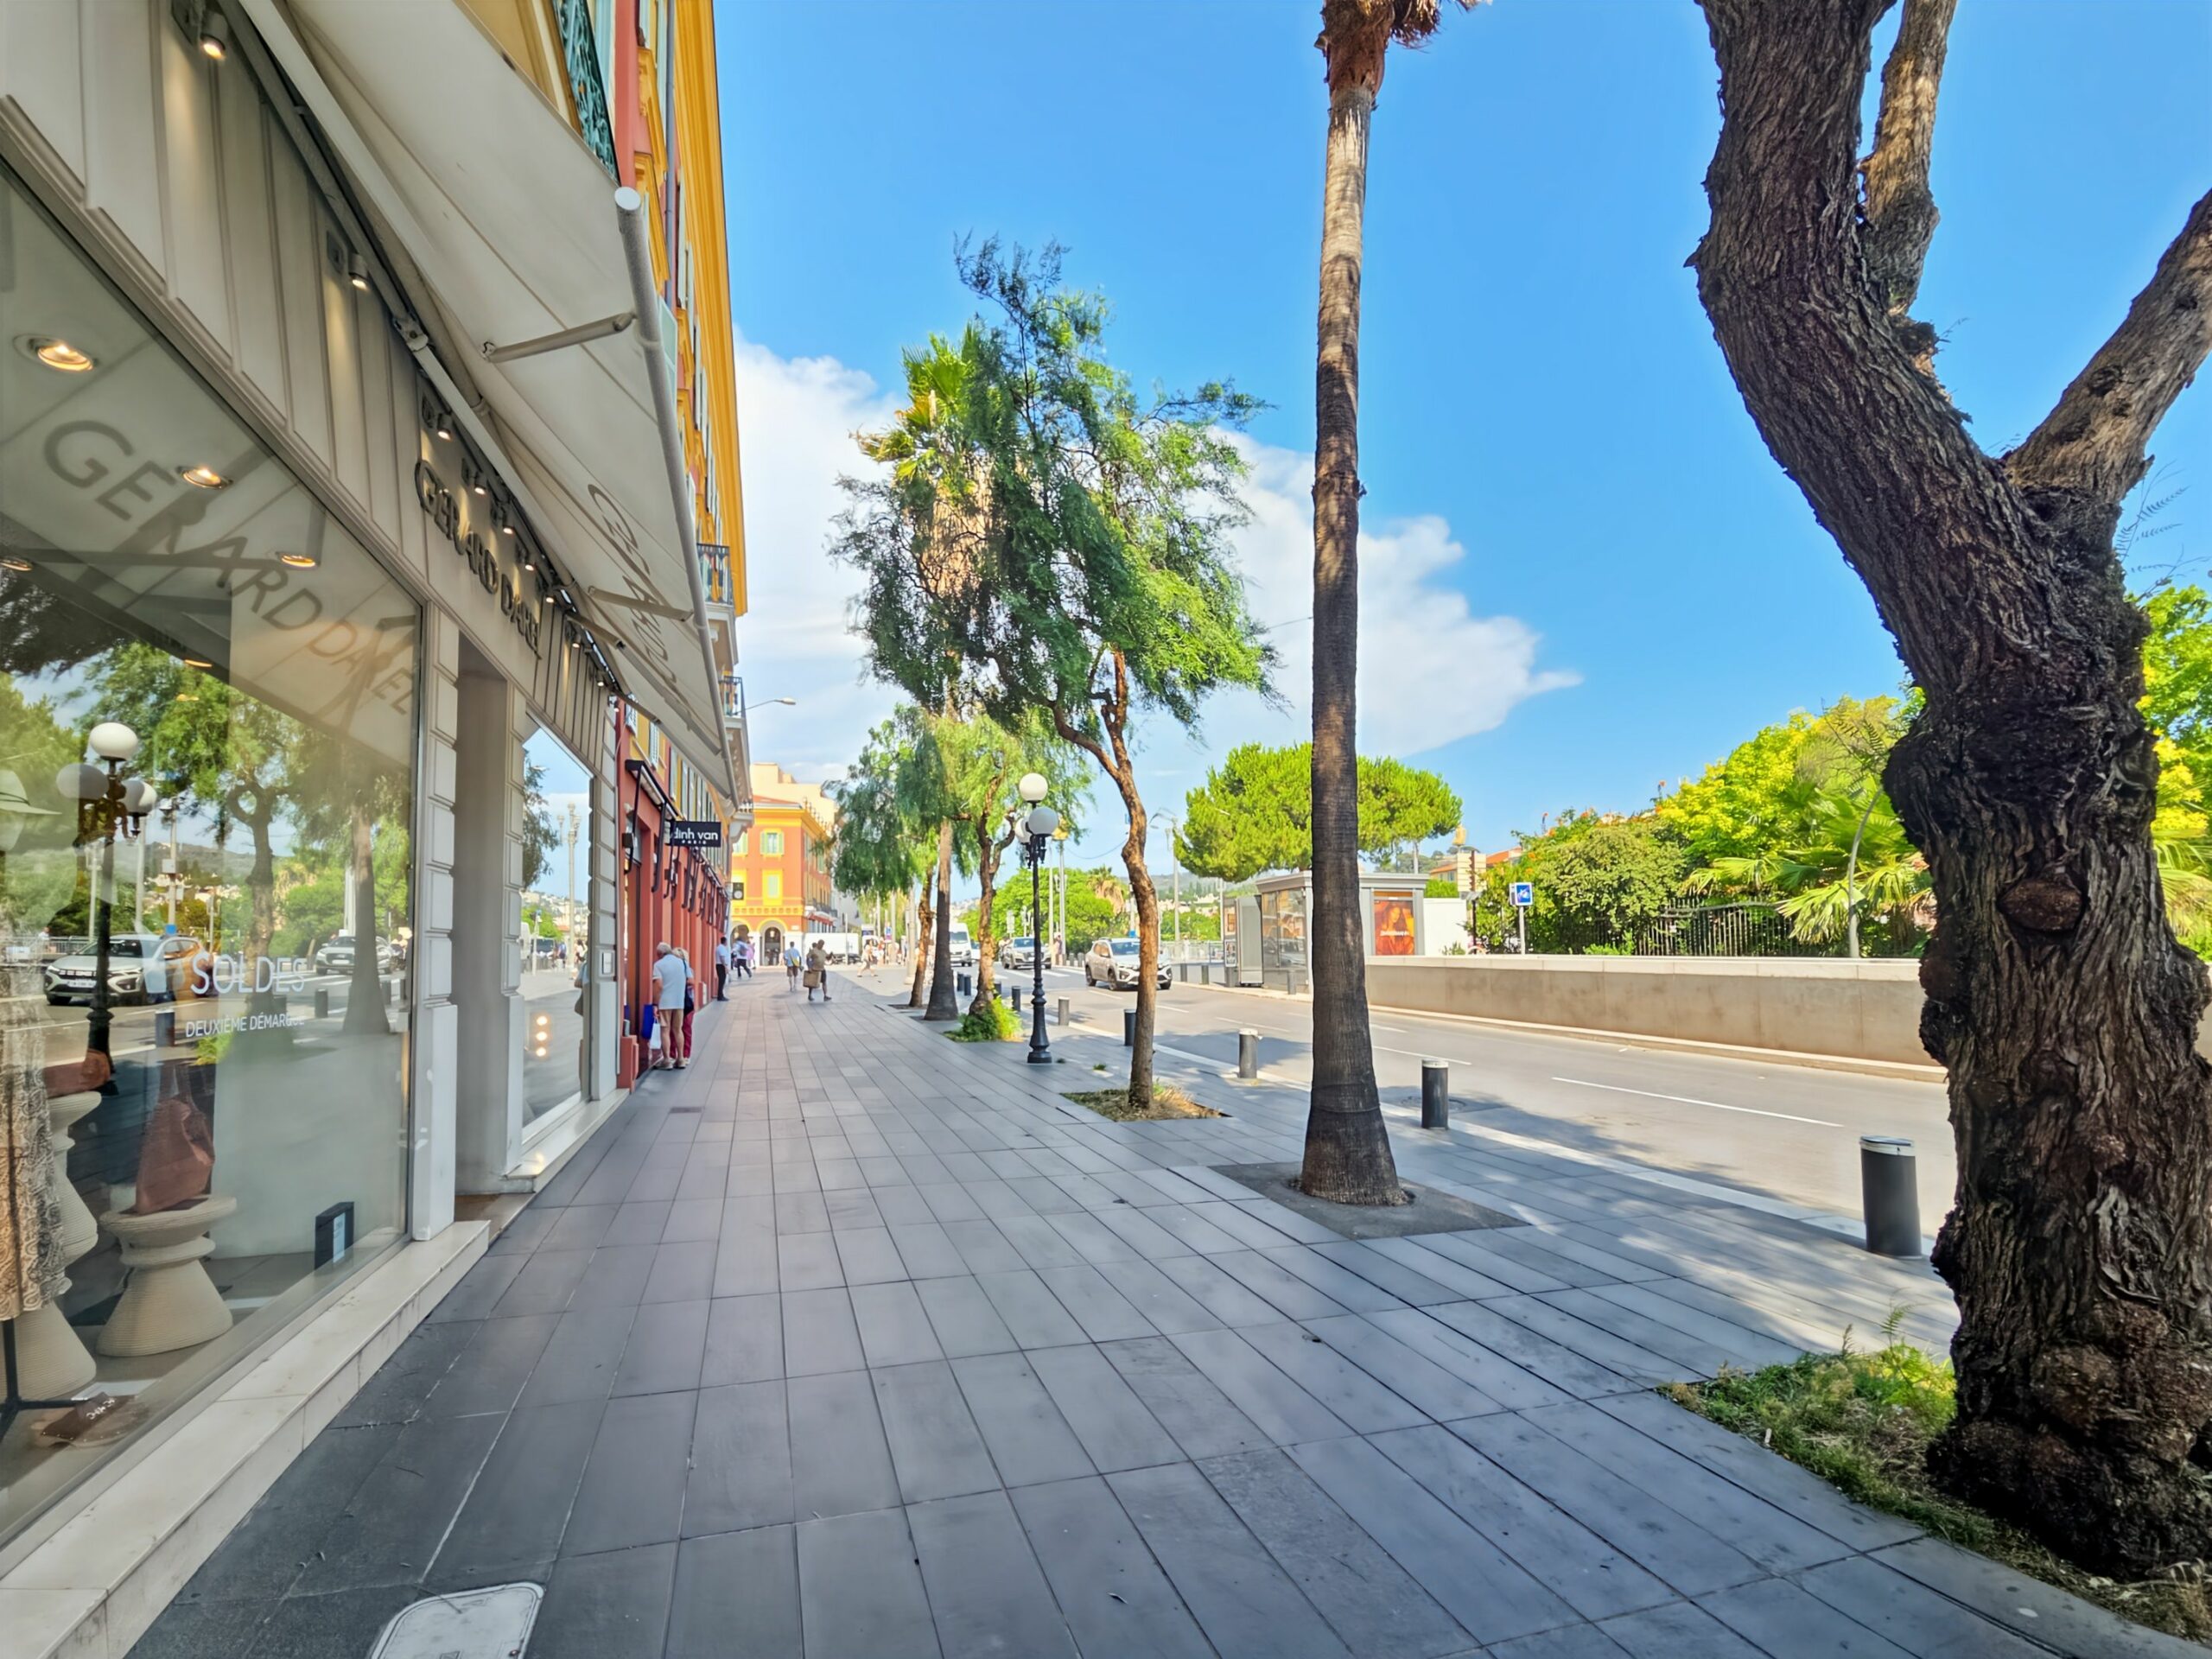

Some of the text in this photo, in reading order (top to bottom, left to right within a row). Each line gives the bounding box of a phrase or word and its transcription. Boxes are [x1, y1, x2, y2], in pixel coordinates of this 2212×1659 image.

[415, 460, 499, 594] GERARD
[697, 831, 718, 840] van
[191, 951, 305, 995] SOLDES
[186, 1012, 305, 1038] DEUXIÈME DÉMARQUE
